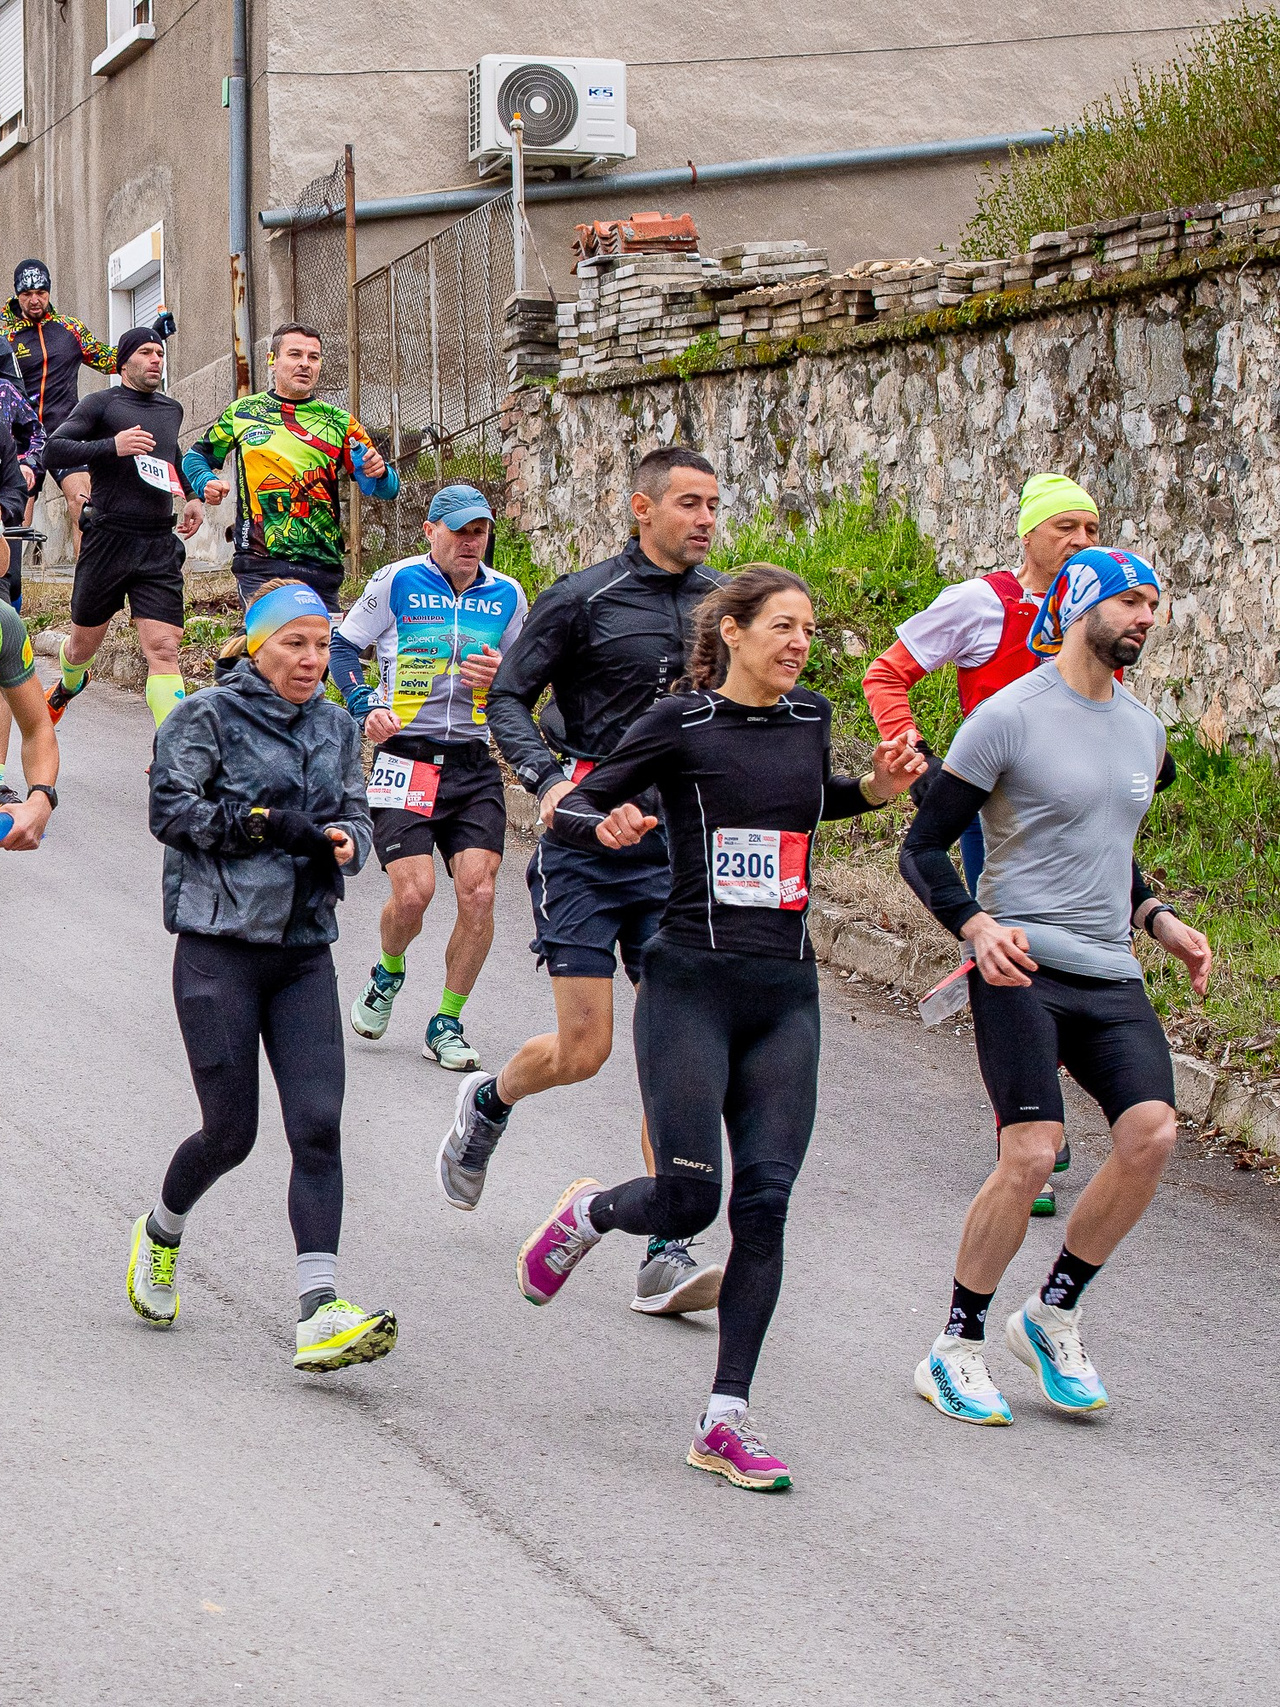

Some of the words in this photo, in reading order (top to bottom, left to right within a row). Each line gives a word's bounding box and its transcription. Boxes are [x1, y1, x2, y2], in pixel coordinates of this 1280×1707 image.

[140, 461, 164, 478] 2181
[408, 594, 503, 616] SIEMENS
[400, 680, 429, 688] DEVIN
[716, 852, 775, 879] 2306
[672, 1157, 707, 1171] CRAFT
[930, 1364, 967, 1413] BROOKS
